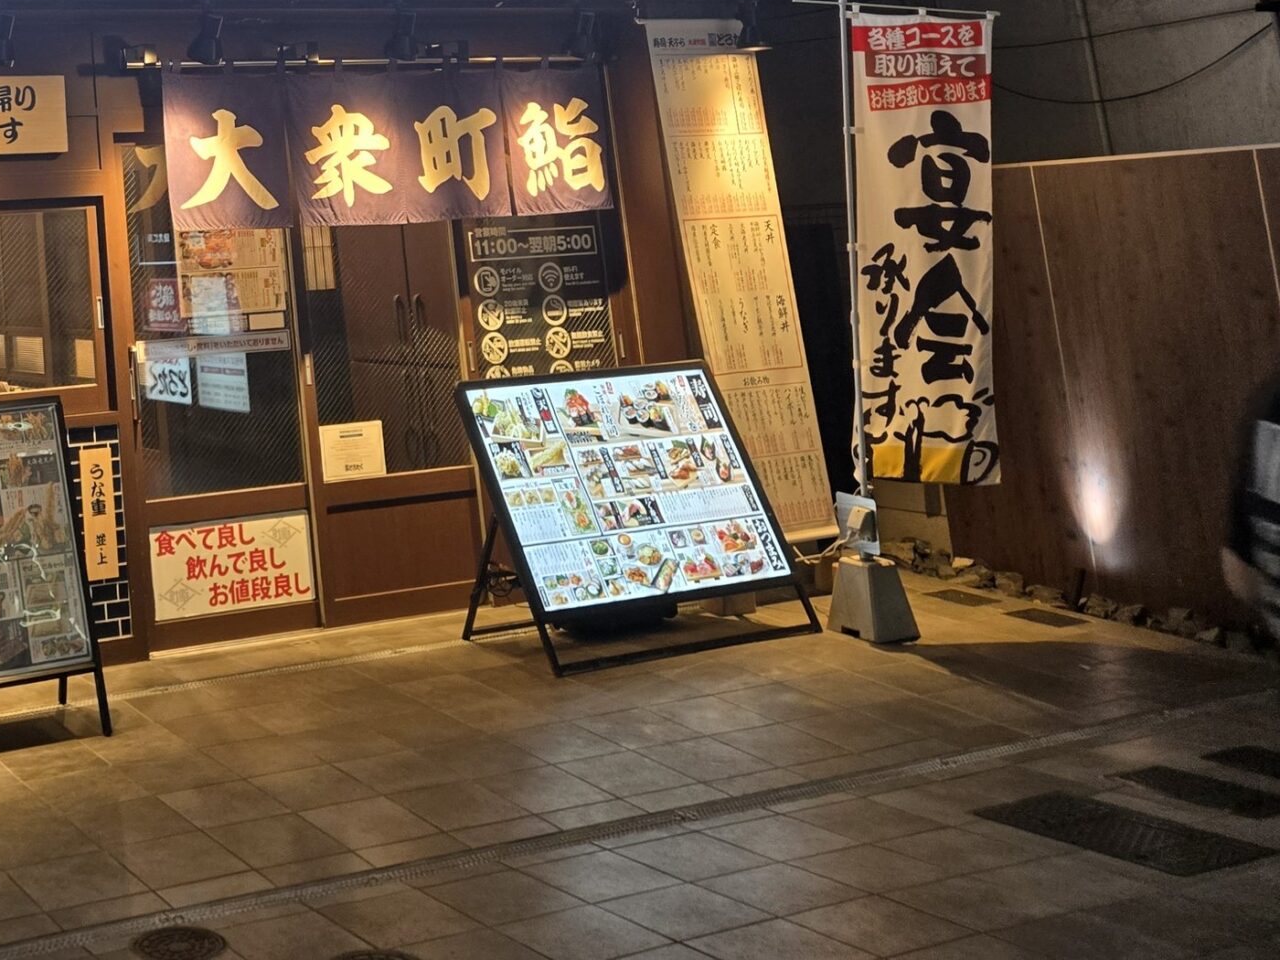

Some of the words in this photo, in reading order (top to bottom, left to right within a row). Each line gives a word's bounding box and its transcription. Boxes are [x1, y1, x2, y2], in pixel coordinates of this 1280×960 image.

[867, 24, 975, 51] 各種コースを
[874, 53, 977, 77] 取り揃えて
[870, 79, 987, 109] お待ち致しております
[180, 97, 607, 211] 大衆町鮨
[887, 110, 993, 385] 宴会
[861, 243, 911, 427] 承ります
[742, 375, 770, 386] お飲み物
[688, 377, 719, 424] 寿司
[89, 463, 107, 517] うな重
[154, 523, 255, 557] 食べて良し
[185, 547, 286, 581] 飲んで良し
[208, 572, 310, 608] お値段良し
